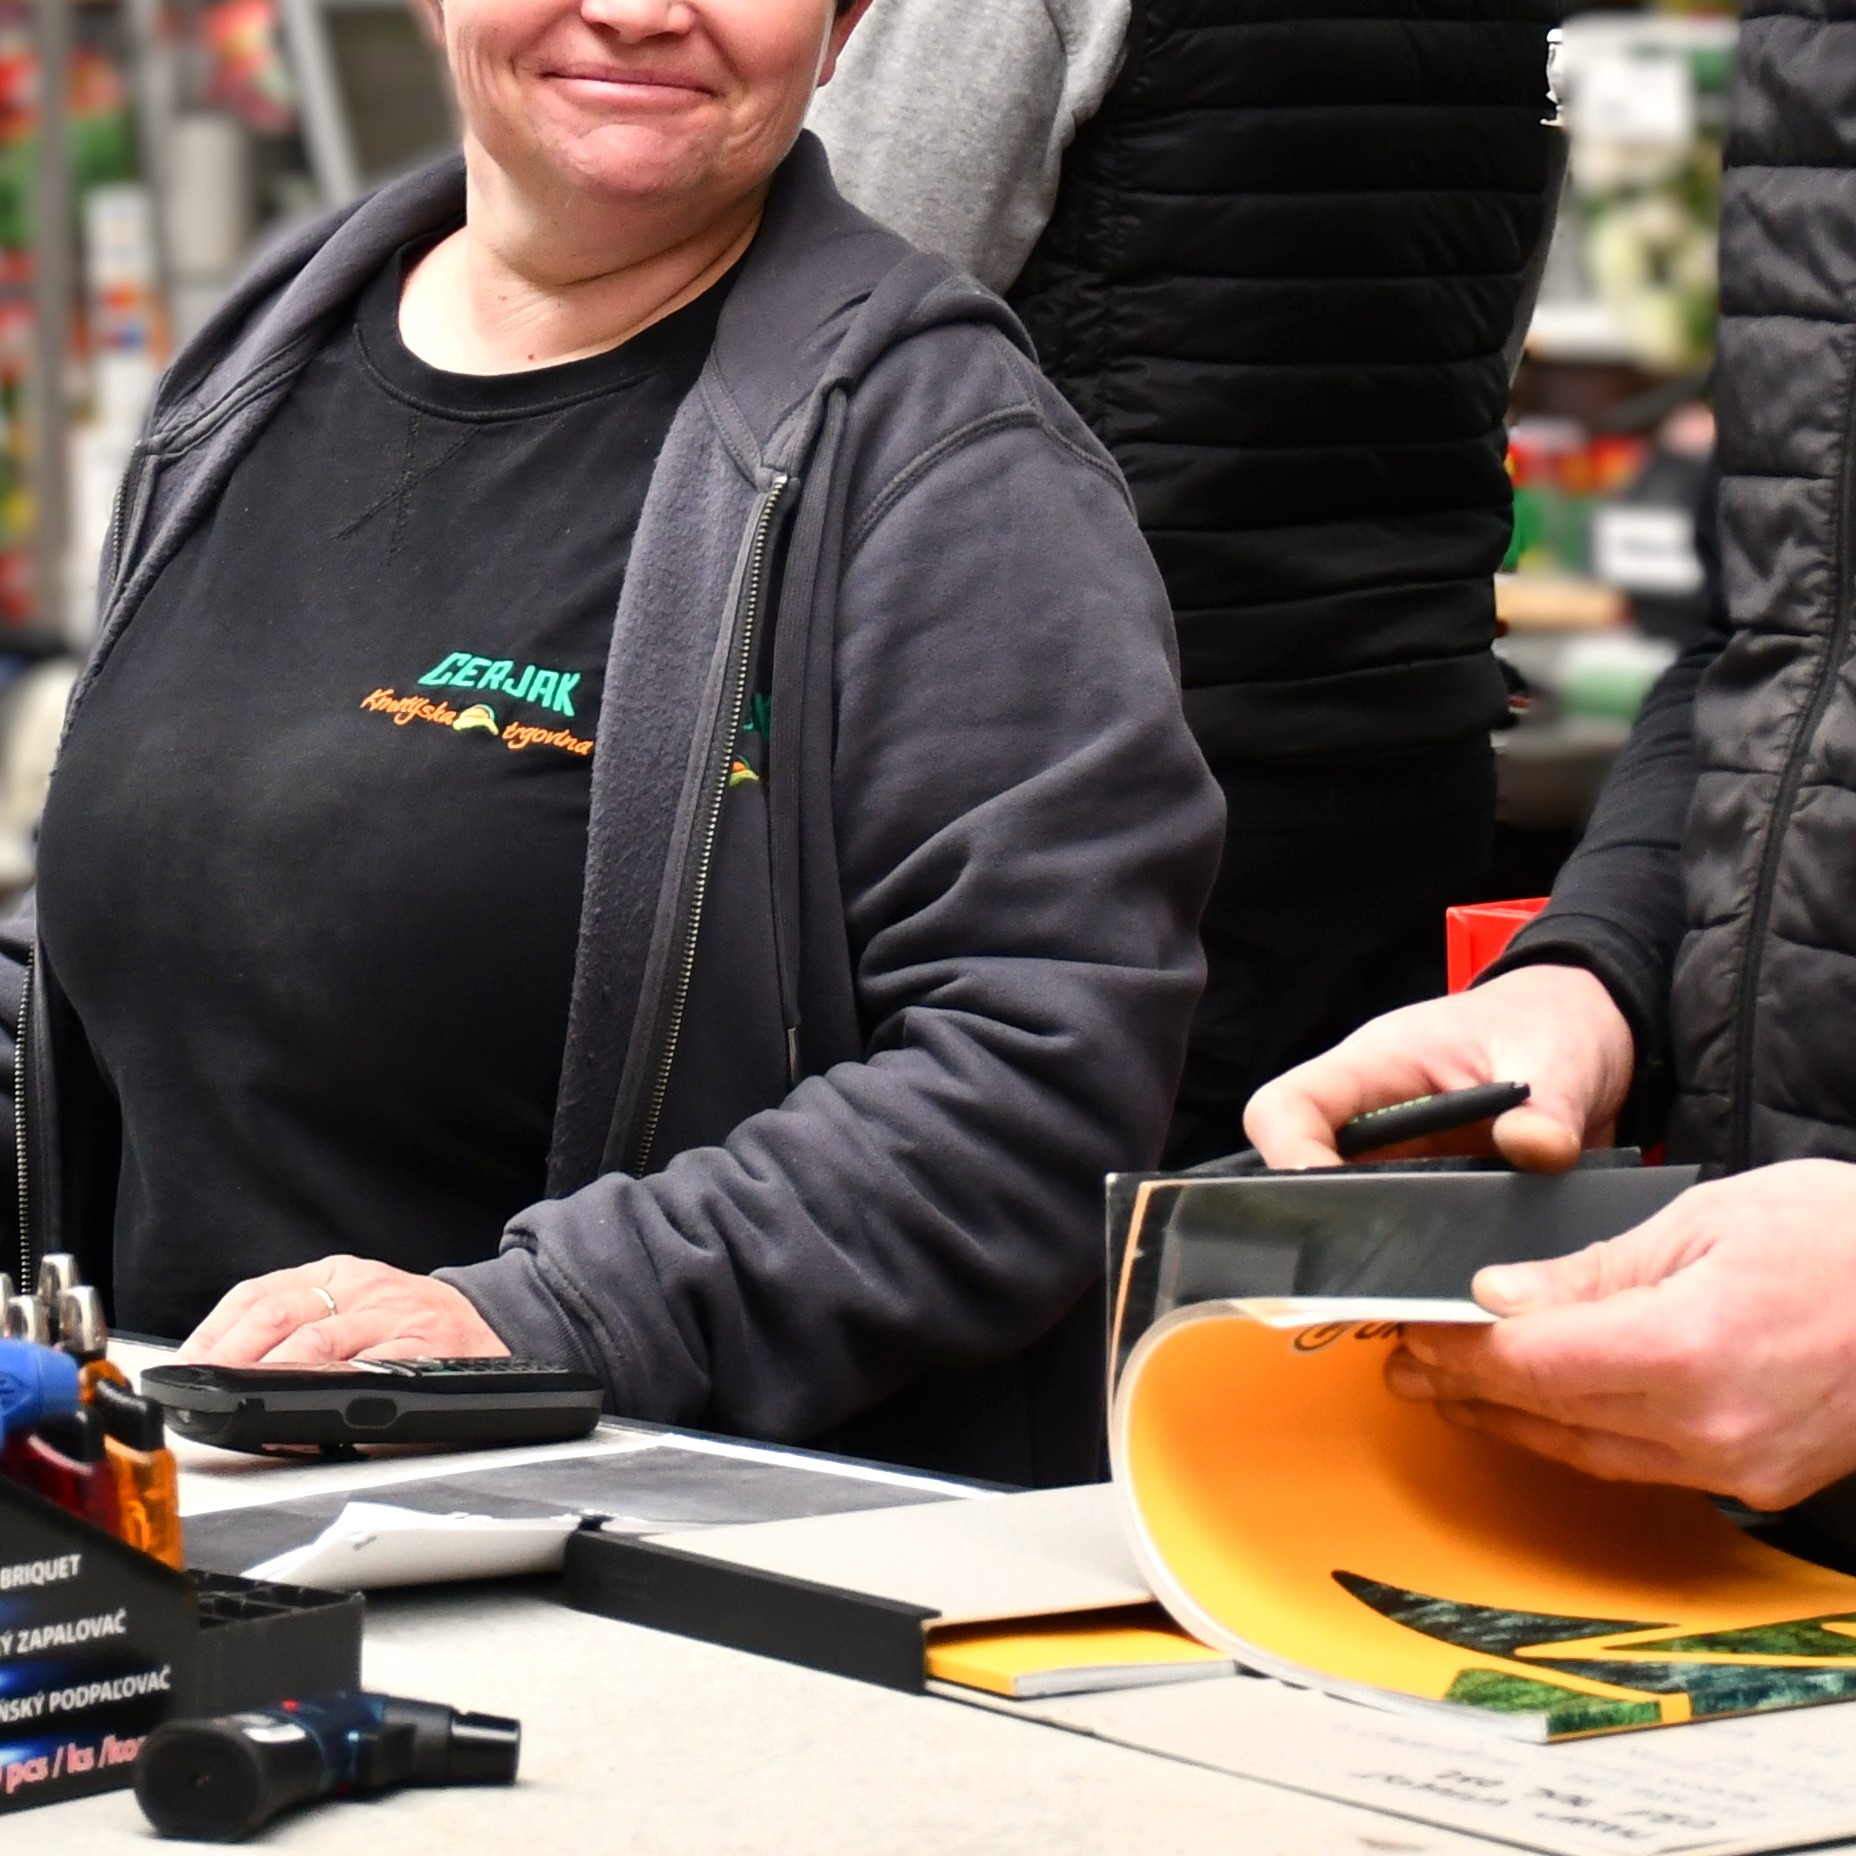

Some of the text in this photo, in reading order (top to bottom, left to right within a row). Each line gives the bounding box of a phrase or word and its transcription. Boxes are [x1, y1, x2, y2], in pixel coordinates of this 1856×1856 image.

[417, 651, 580, 717] CERJAK
[359, 687, 595, 756] Kmetijska trgovina
[0, 1554, 82, 1590] BRIQUET
[17, 1608, 128, 1654] ZAPALOVAČ
[49, 1665, 172, 1714] PODPAĽOVAČ
[6, 1757, 49, 1794] pcs
